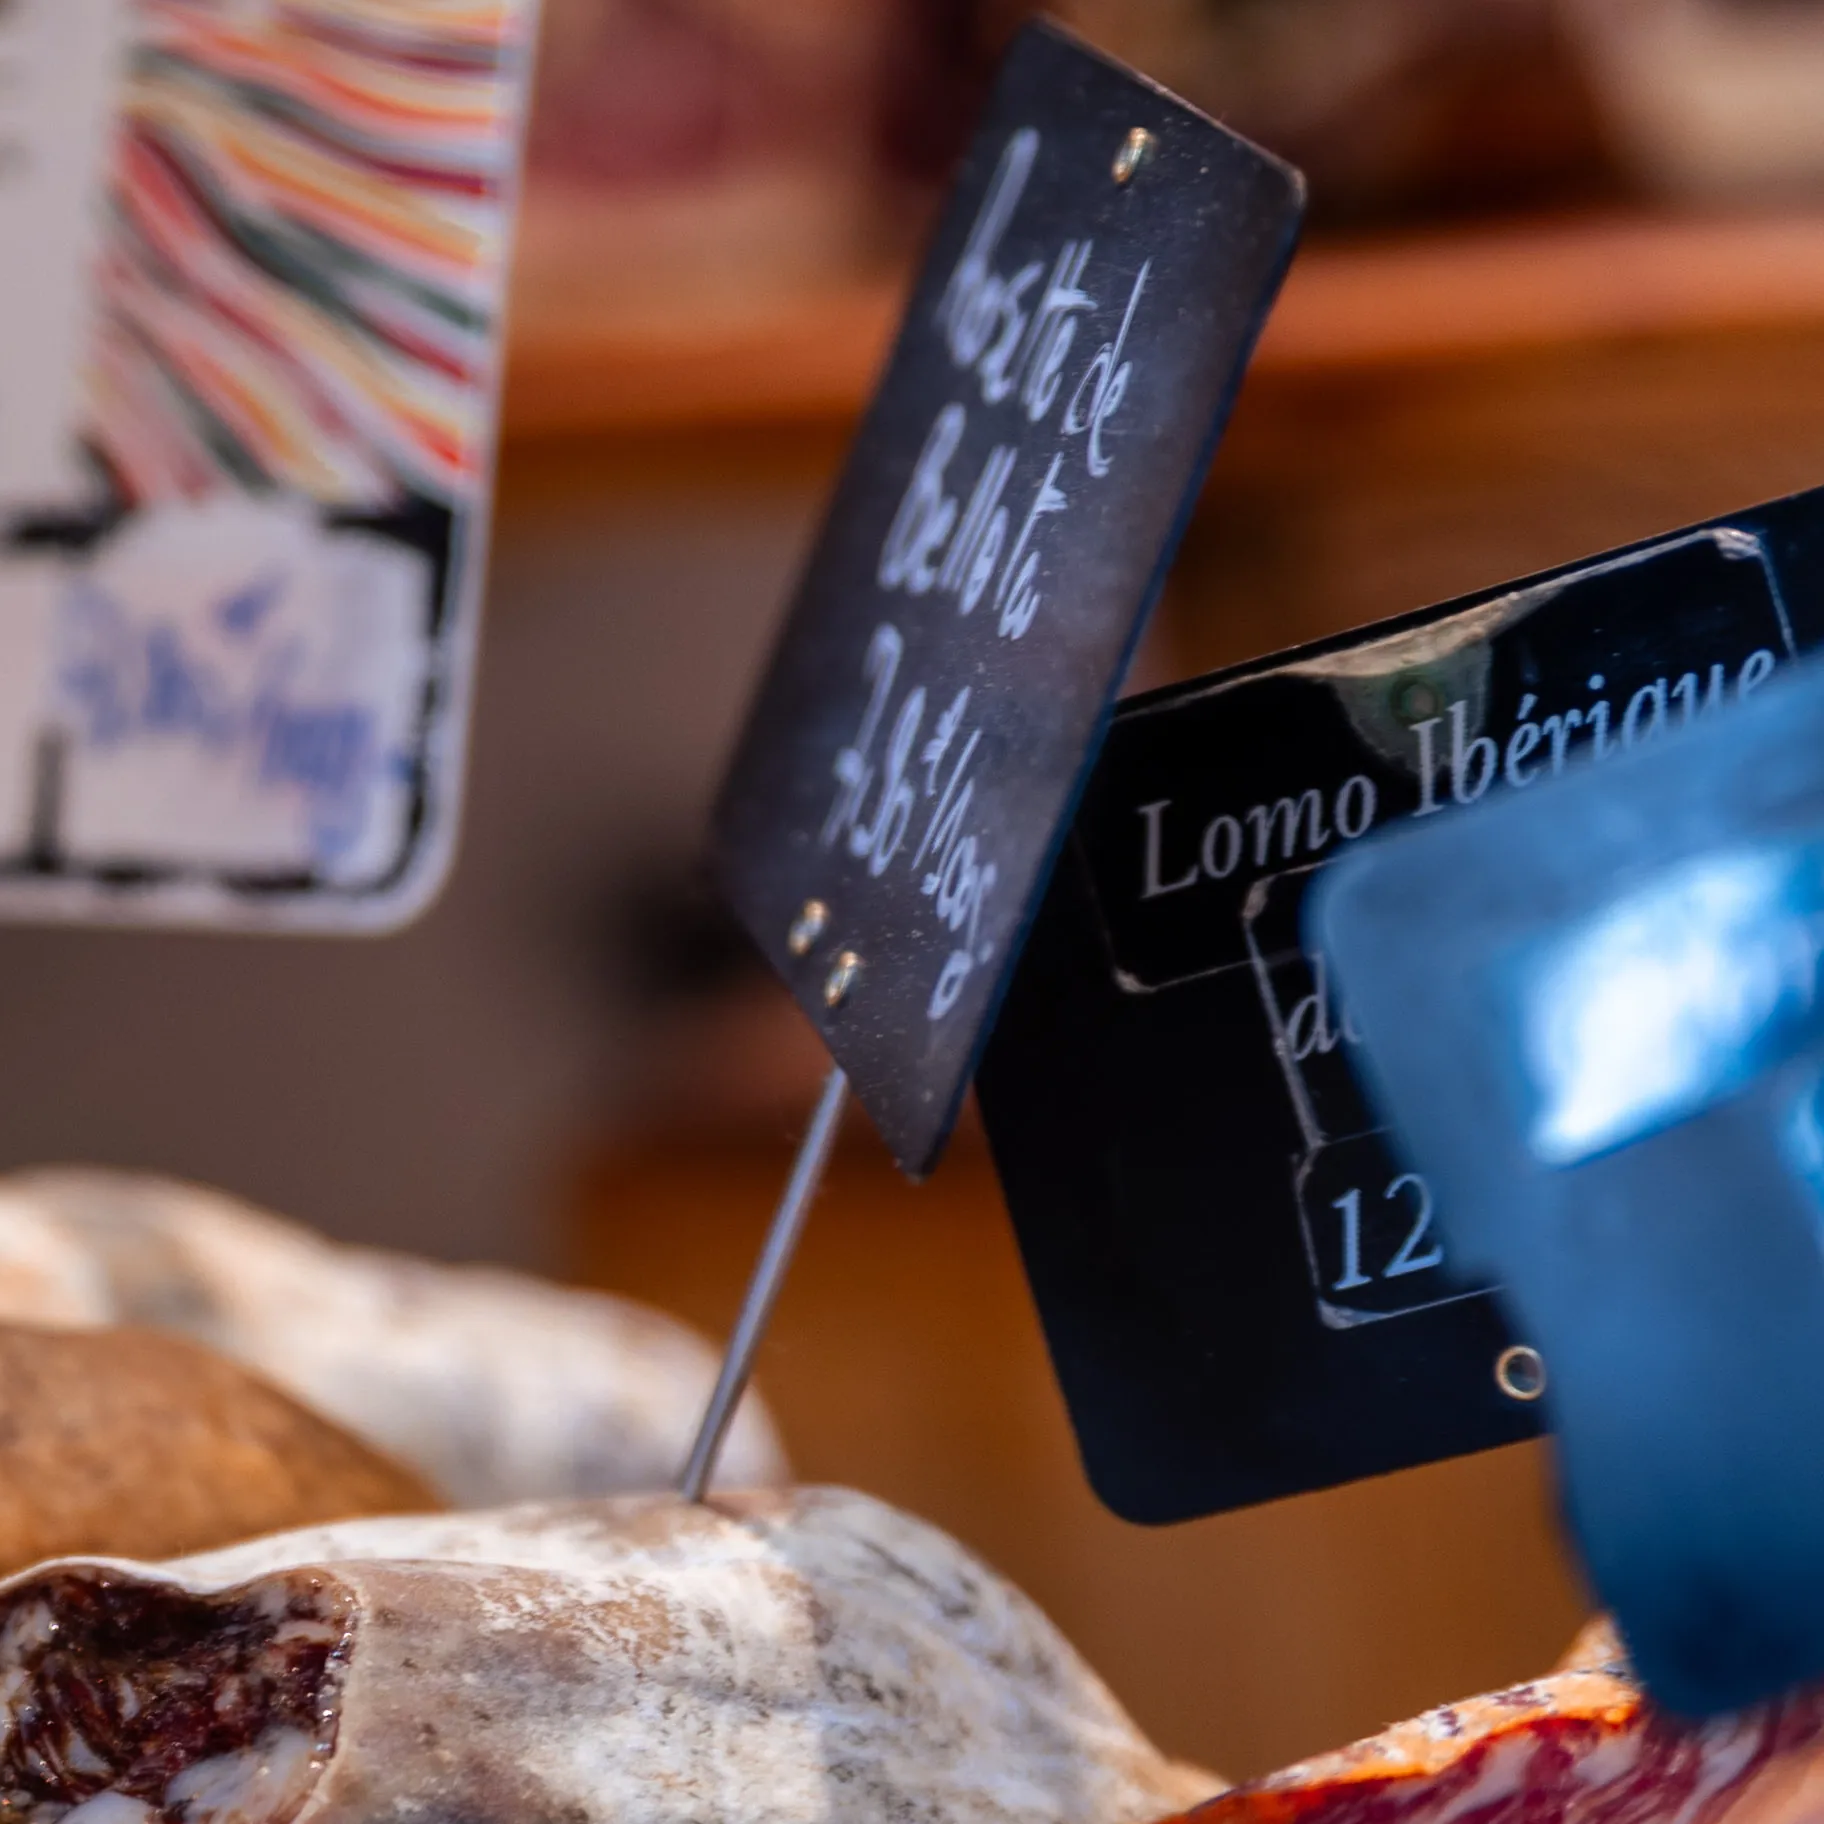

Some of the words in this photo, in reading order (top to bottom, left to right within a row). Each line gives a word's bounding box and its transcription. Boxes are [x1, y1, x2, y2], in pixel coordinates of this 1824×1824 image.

[1061, 256, 1152, 477] de
[879, 402, 1068, 641] Bellota
[1137, 774, 1376, 899] Lomo
